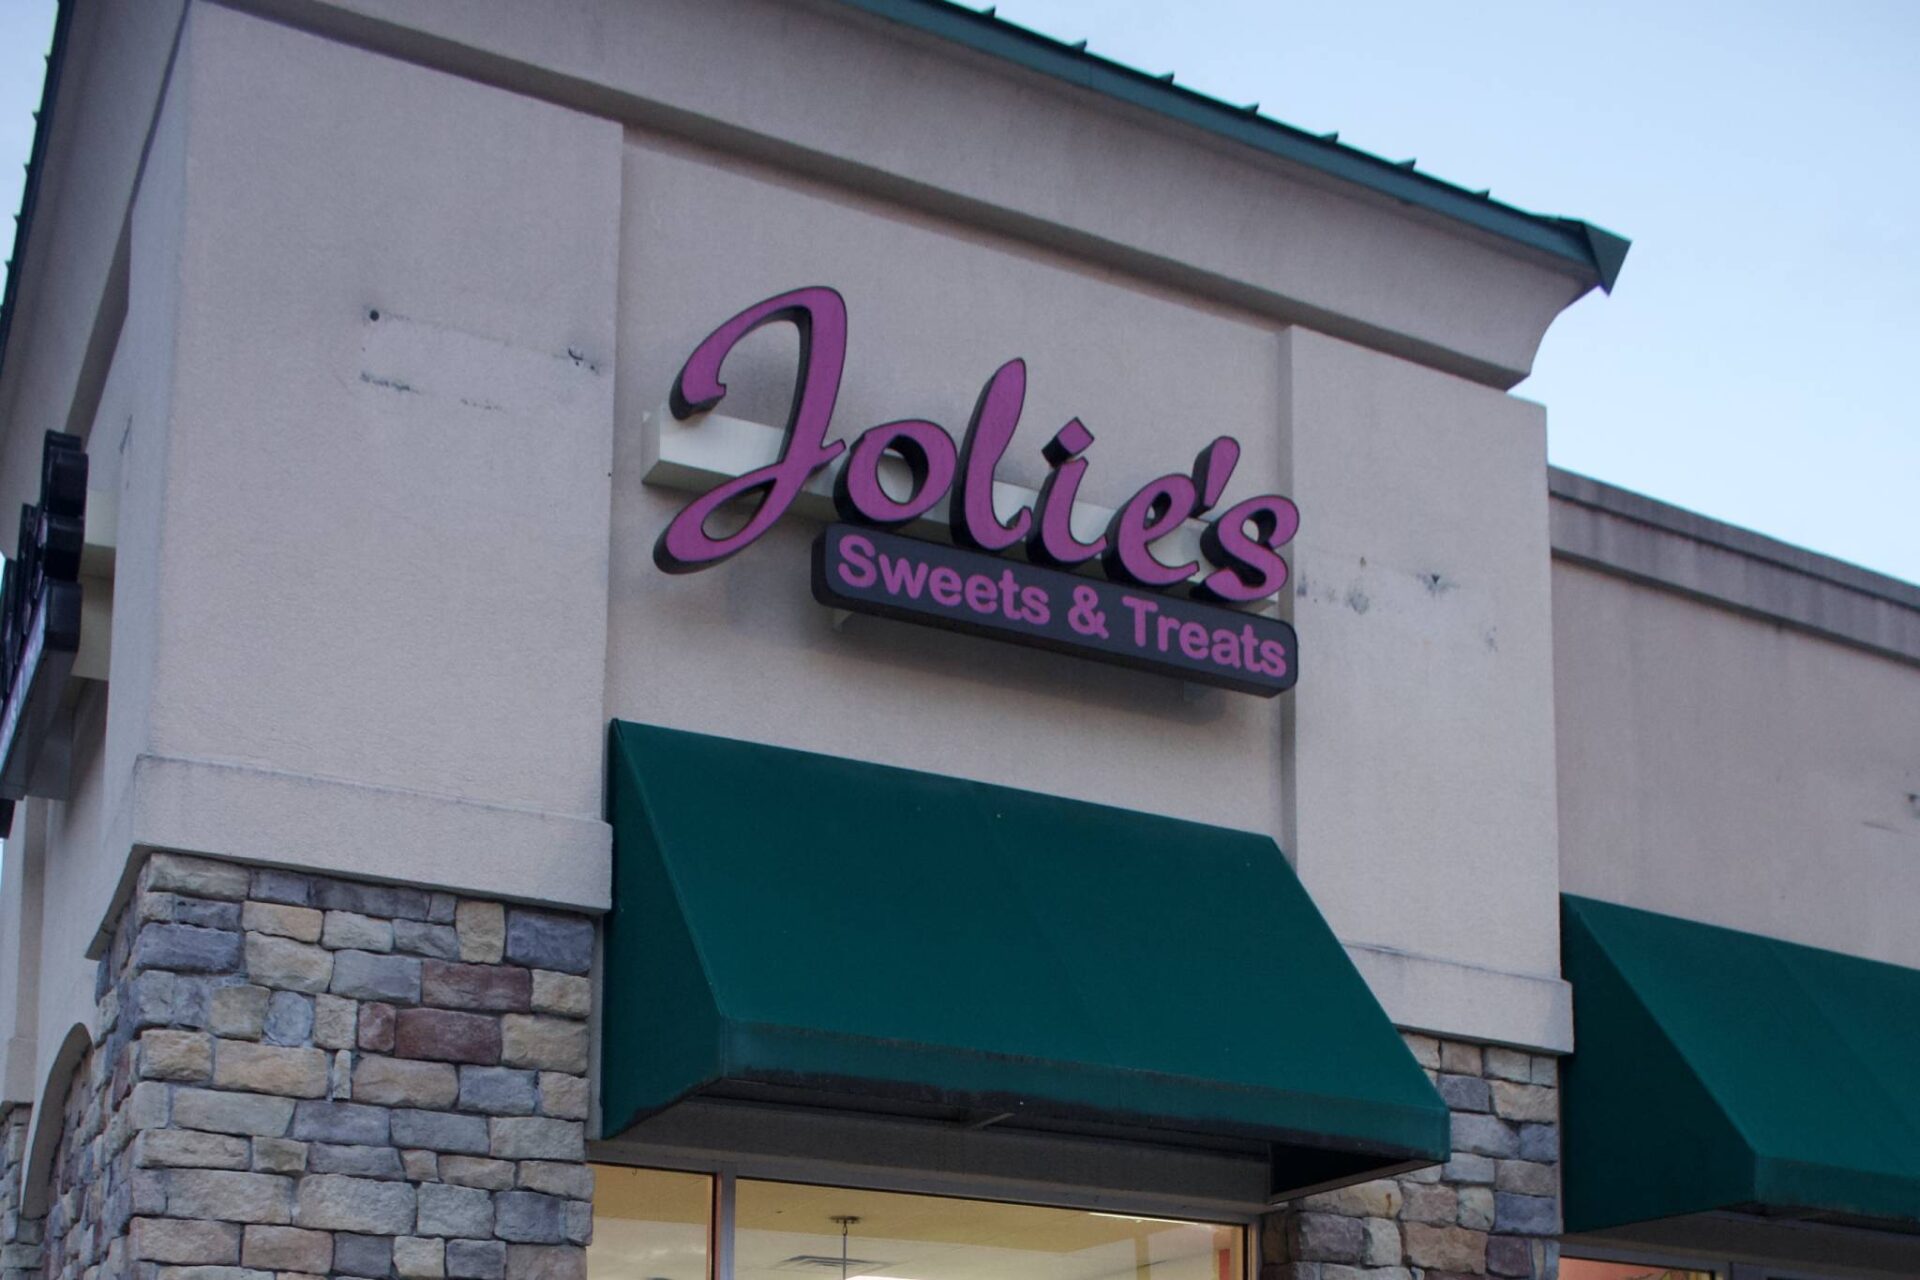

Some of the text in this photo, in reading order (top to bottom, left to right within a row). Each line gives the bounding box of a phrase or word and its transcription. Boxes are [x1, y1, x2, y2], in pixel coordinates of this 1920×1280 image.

[658, 286, 1299, 603] Jolie's
[837, 533, 1288, 678] Sweets & Treats
